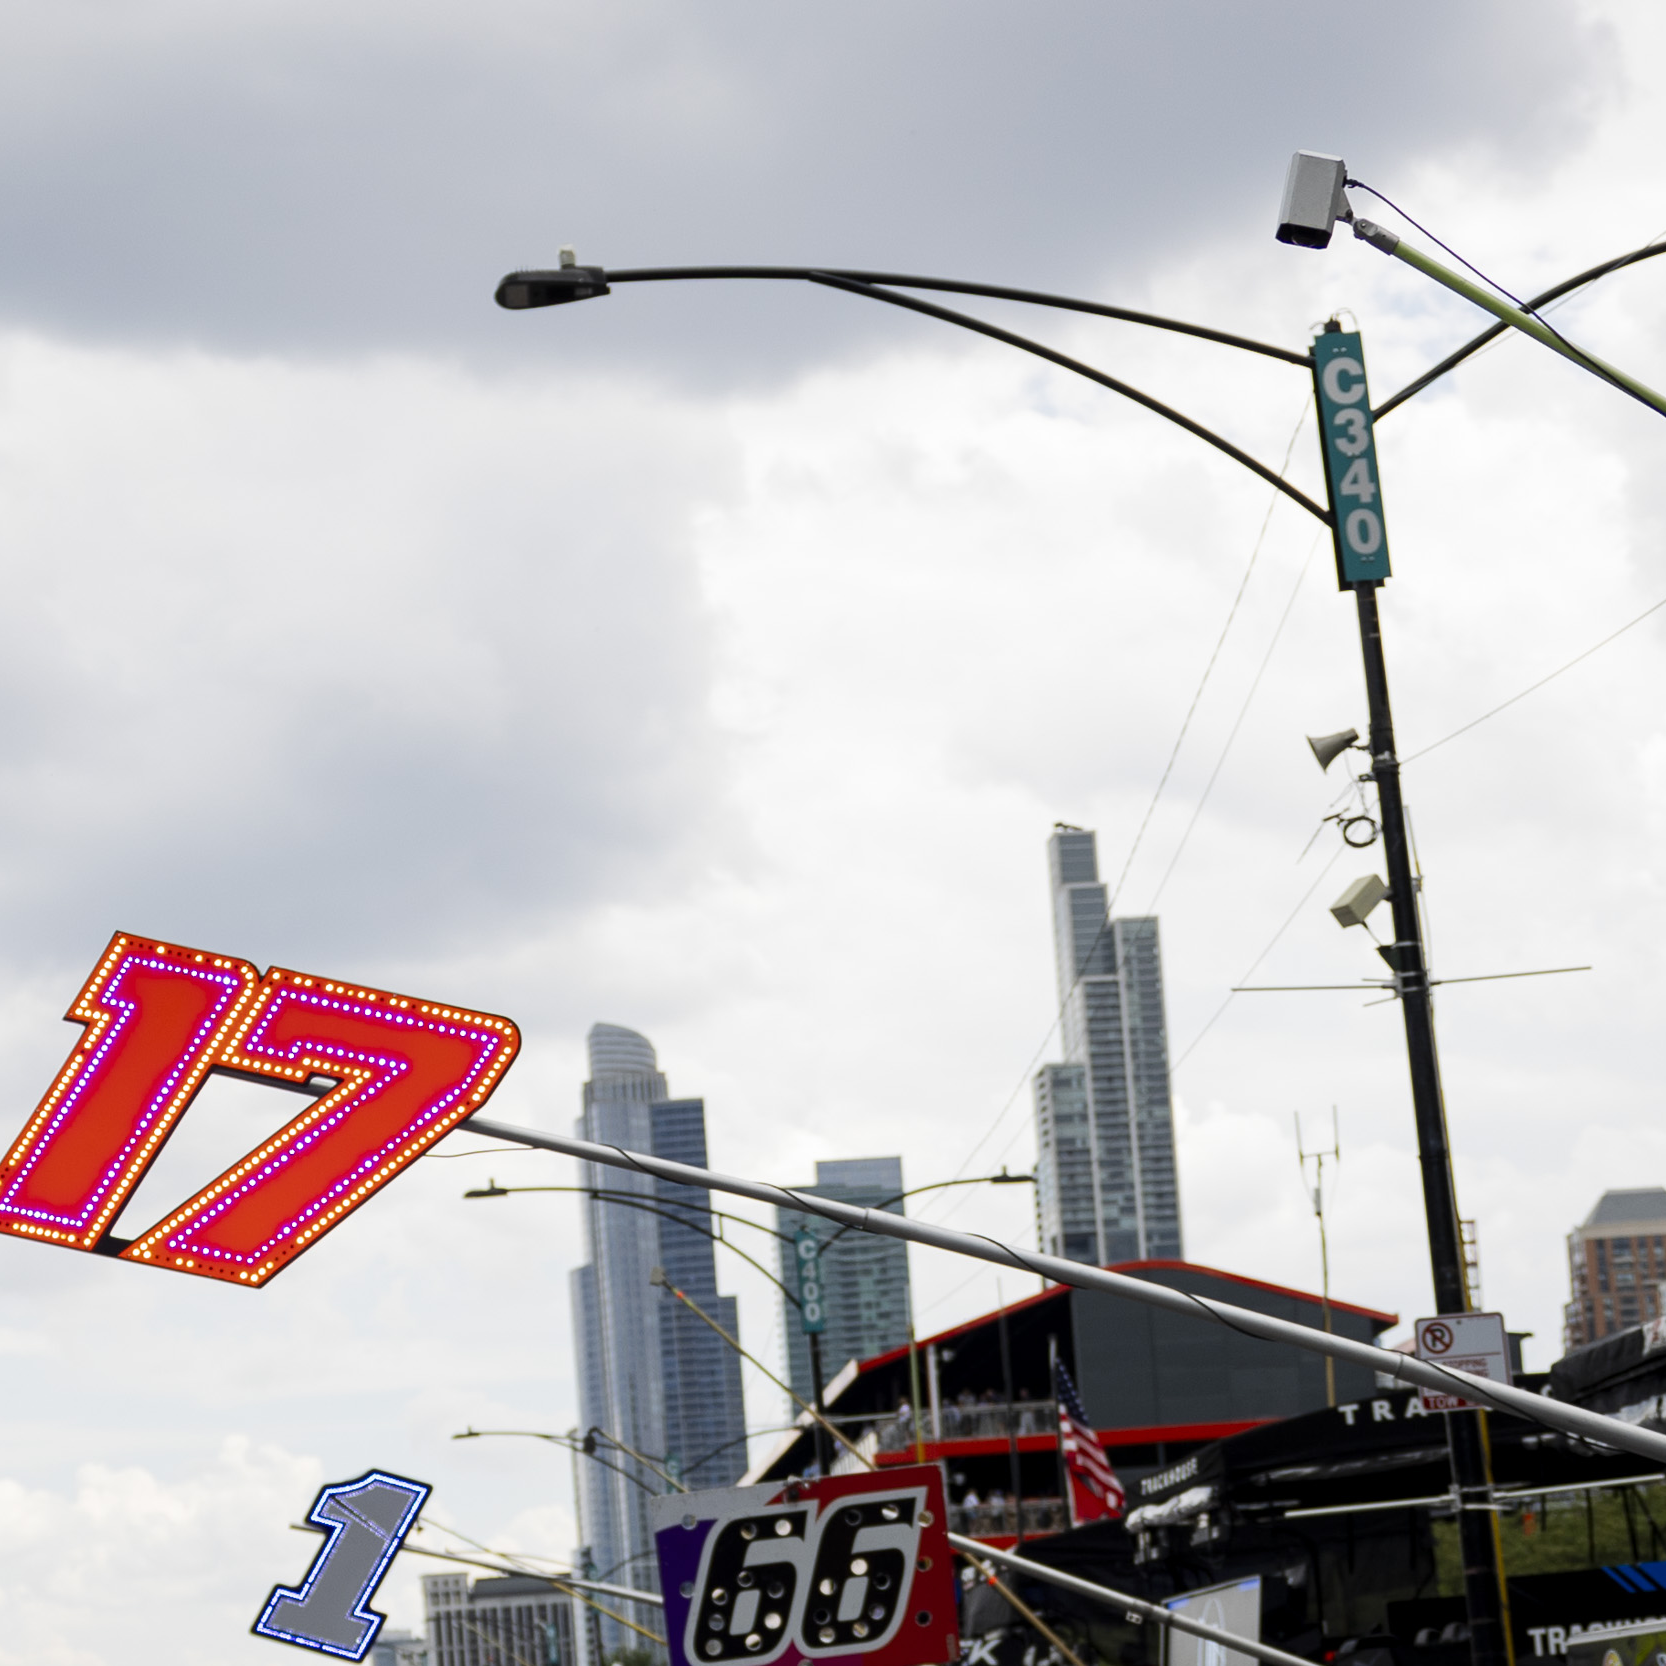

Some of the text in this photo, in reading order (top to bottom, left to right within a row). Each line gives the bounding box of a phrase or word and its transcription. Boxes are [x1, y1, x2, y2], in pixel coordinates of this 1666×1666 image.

[1322, 356, 1381, 555] C340
[798, 1240, 821, 1322] C400
[1140, 1456, 1199, 1496] TRACKHOUSE
[252, 1469, 432, 1663] 1
